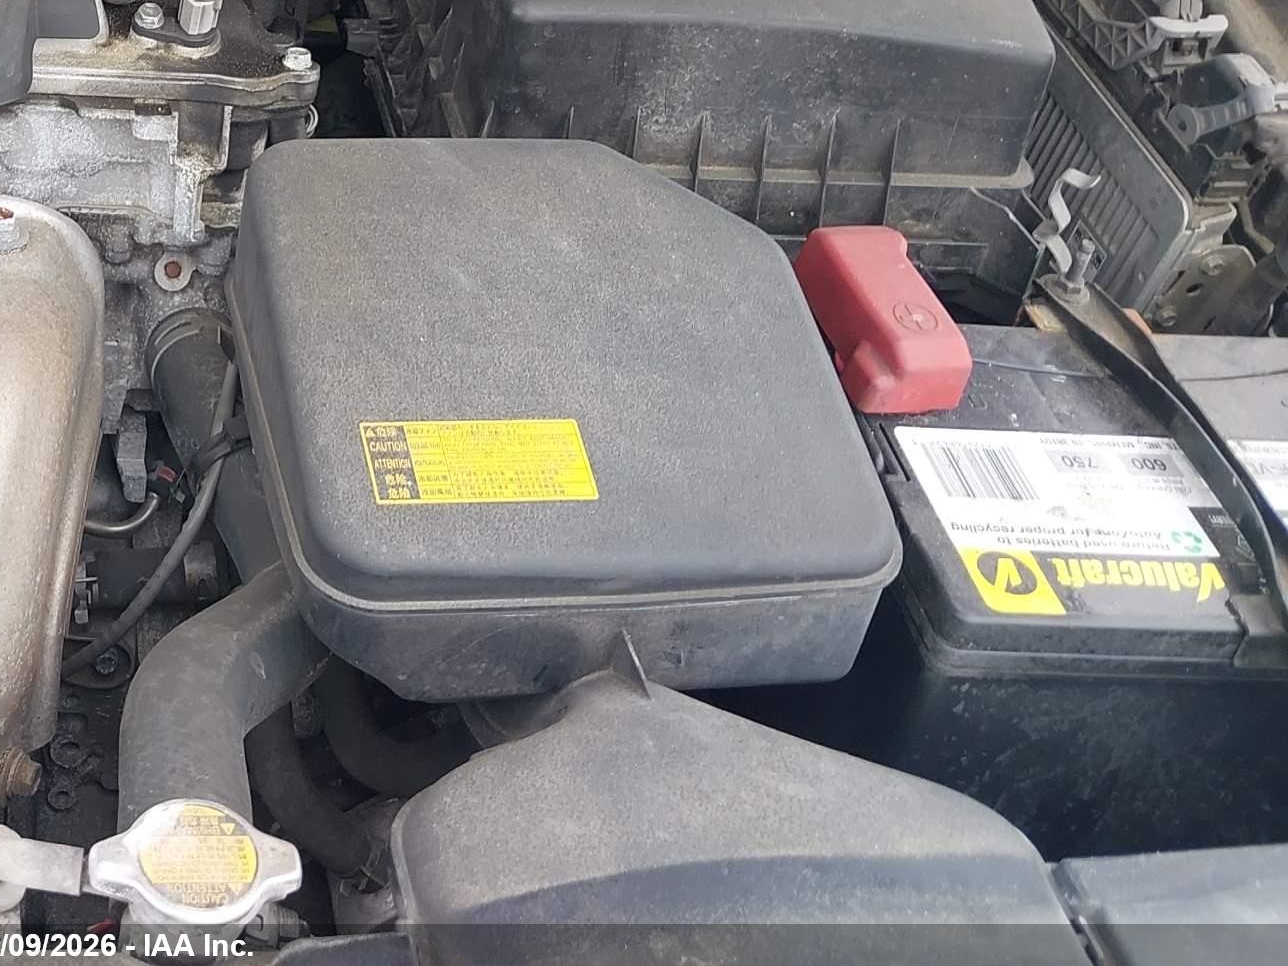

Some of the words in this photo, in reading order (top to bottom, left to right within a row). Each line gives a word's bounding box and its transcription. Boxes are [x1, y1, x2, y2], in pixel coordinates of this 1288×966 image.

[369, 441, 408, 452] CAUTION
[374, 458, 412, 470] ATTENTION
[1061, 455, 1098, 469] 750
[1131, 457, 1168, 472] 600
[950, 521, 1015, 535] recycling
[997, 537, 1012, 547] to
[1015, 536, 1080, 549] batteries
[1055, 557, 1226, 603] Valucraft
